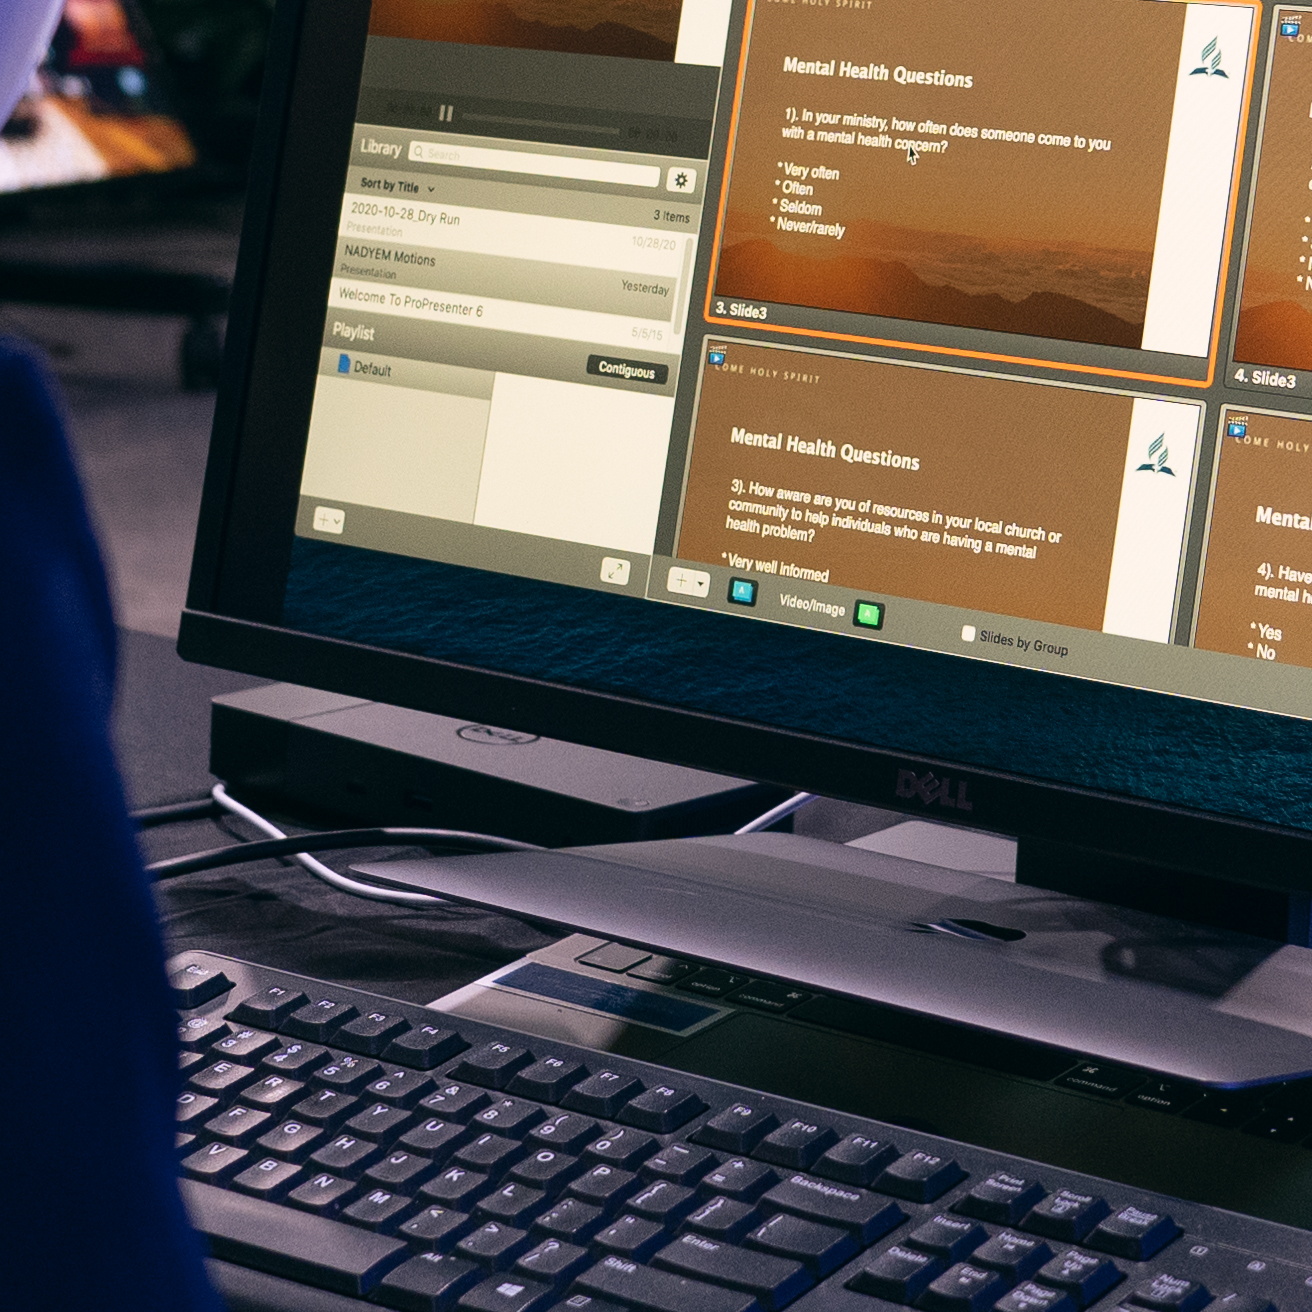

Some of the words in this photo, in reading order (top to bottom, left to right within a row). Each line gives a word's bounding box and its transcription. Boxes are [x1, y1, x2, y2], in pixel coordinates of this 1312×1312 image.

[783, 56, 835, 76] Mental
[838, 60, 889, 80] Health
[893, 65, 972, 88] Questions
[801, 107, 813, 122] In
[814, 112, 841, 126] your
[841, 113, 888, 132] ministry,
[890, 116, 916, 131] how
[916, 119, 947, 134] often
[948, 122, 978, 138] does
[980, 128, 1035, 143] someone
[1036, 133, 1071, 147] come
[1072, 134, 1086, 148] to
[1087, 138, 1111, 152] you
[360, 137, 402, 158] Library
[781, 125, 804, 139] with
[805, 129, 815, 141] a
[816, 130, 855, 144] mental
[856, 131, 892, 148] health
[893, 138, 948, 154] concern?
[427, 147, 460, 162] Search
[783, 161, 809, 180] Very
[810, 165, 840, 180] often
[360, 176, 381, 189] Sort
[382, 179, 395, 192] by
[397, 180, 419, 193] Title
[781, 179, 813, 195] Often
[351, 201, 436, 224] 2020-10-28_Dry
[438, 211, 460, 225] Run
[652, 208, 660, 220] 3
[662, 210, 690, 224] Items
[779, 198, 822, 215] Seldom
[345, 220, 402, 236] Presentation
[776, 216, 845, 239] Never/rarely
[632, 235, 676, 251] 10/28/20
[344, 244, 391, 260] NADYEM
[393, 250, 435, 267] Motions
[339, 262, 396, 279] Presentation
[621, 279, 669, 297] Yesterday
[338, 286, 385, 304] Welcome
[389, 292, 401, 306] To
[403, 294, 472, 315] ProPresenter
[475, 304, 483, 318] 6
[714, 300, 727, 314] 3.
[729, 302, 767, 319] Slide3
[332, 320, 374, 341] Playlist
[631, 326, 663, 341] 5/5/15
[353, 359, 391, 377] Default
[597, 360, 655, 384] Contiguous
[1233, 367, 1248, 382] 4.
[1251, 369, 1296, 388] Slide3
[979, 629, 1014, 646] Slides
[1016, 635, 1031, 652] by
[1033, 639, 1068, 658] Group
[895, 768, 973, 811] DELL
[269, 987, 286, 996] F1
[790, 1175, 860, 1201] Backspace
[682, 1235, 719, 1251] Enter
[603, 1256, 637, 1272] Shift
